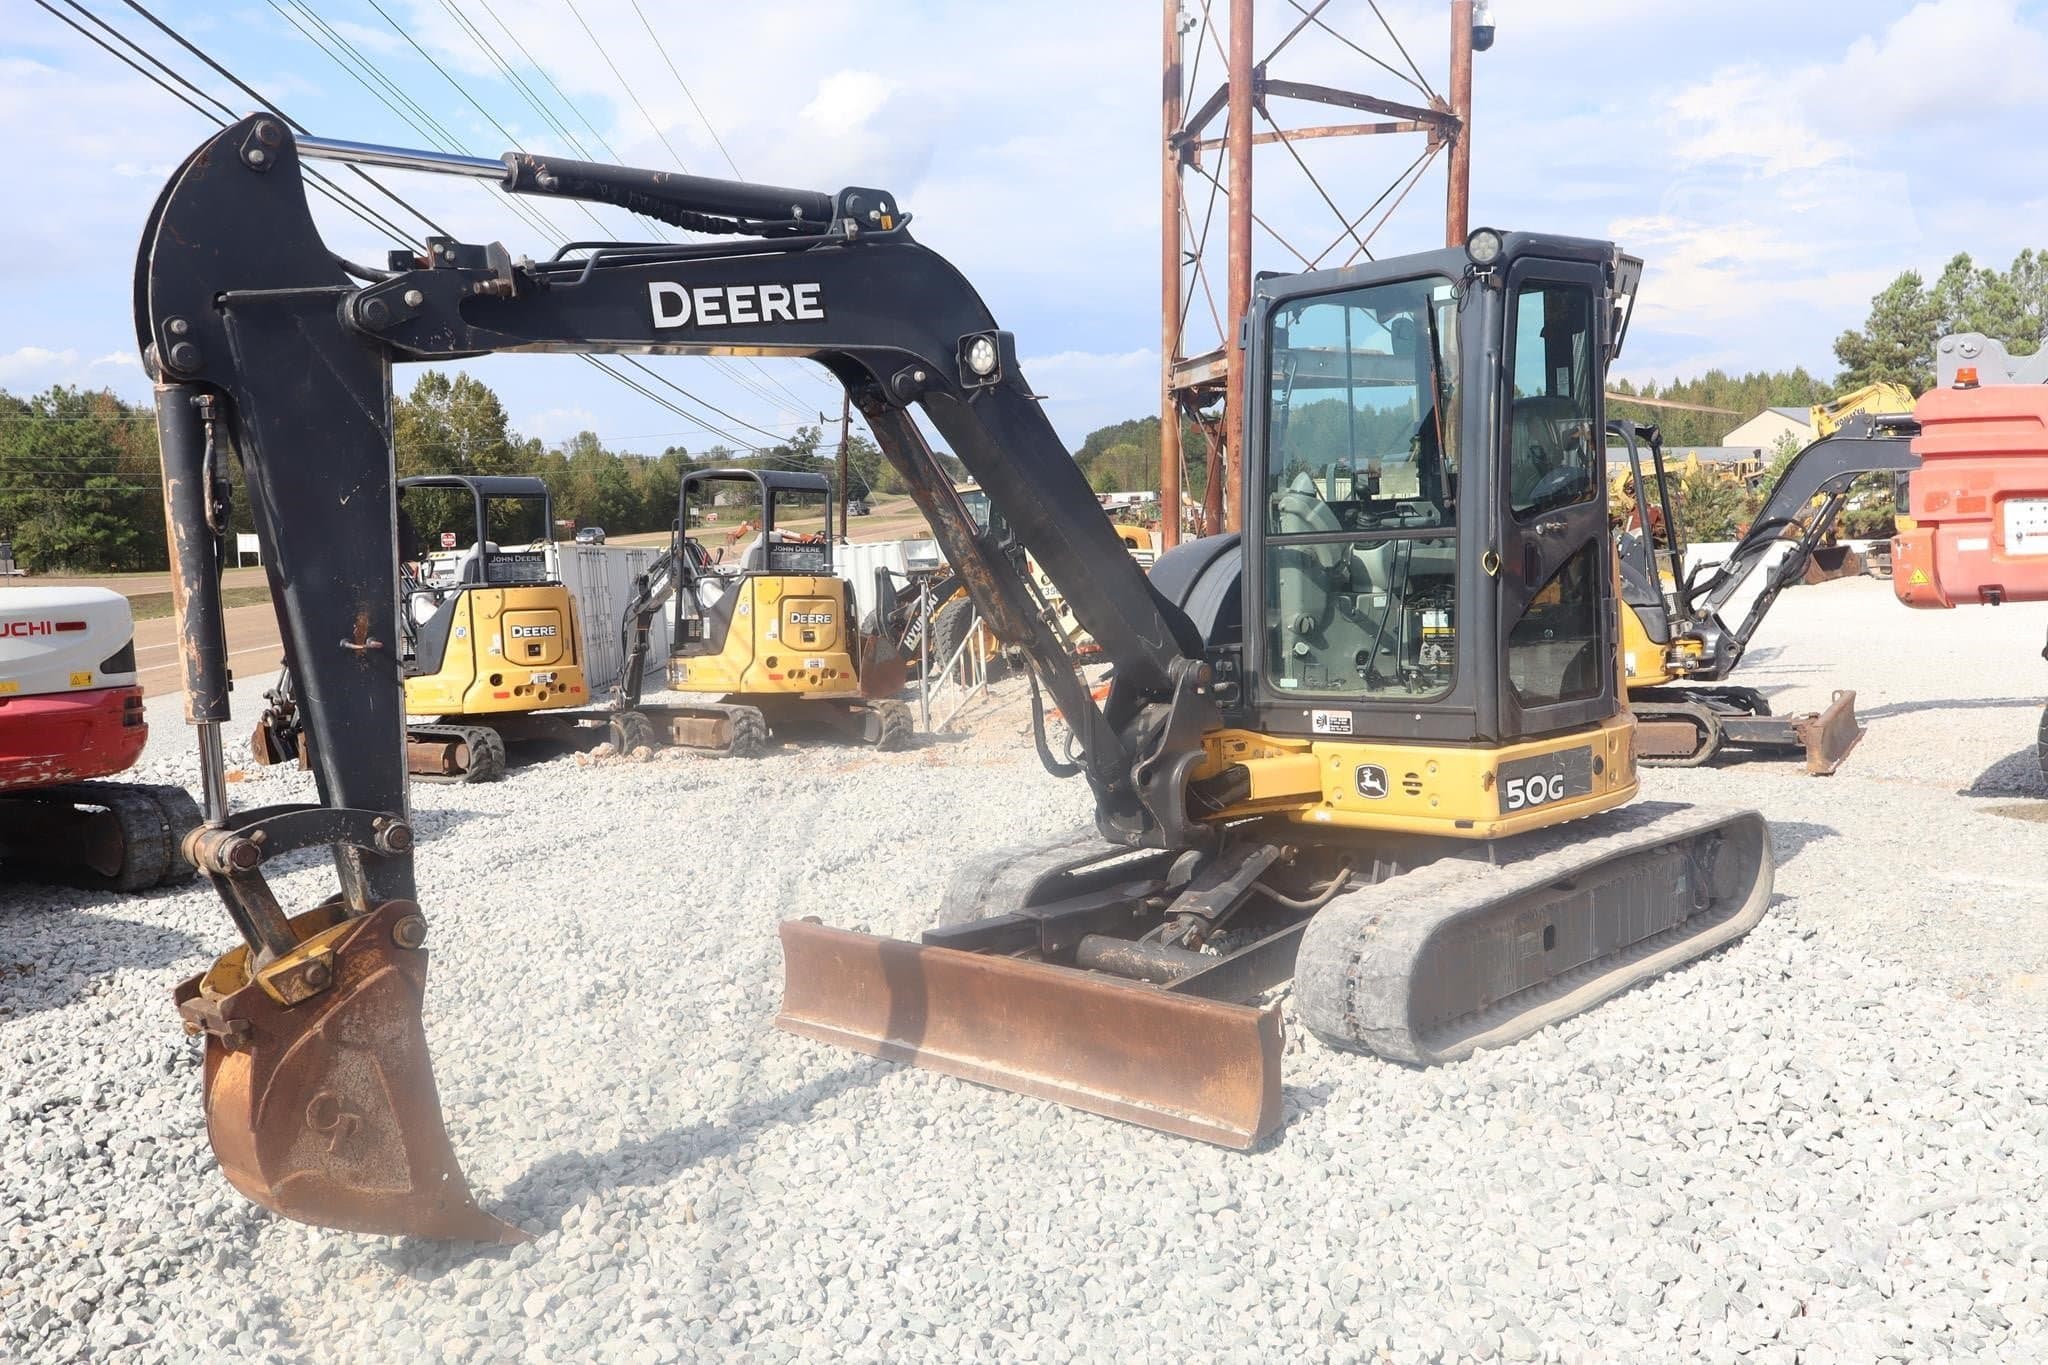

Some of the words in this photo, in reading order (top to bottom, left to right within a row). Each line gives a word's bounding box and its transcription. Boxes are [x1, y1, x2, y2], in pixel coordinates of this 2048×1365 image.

[648, 281, 825, 329] DEERE
[491, 555, 514, 563] JOHN
[790, 612, 832, 624] DEERE
[511, 625, 557, 638] DEERE
[1506, 774, 1564, 809] 50G
